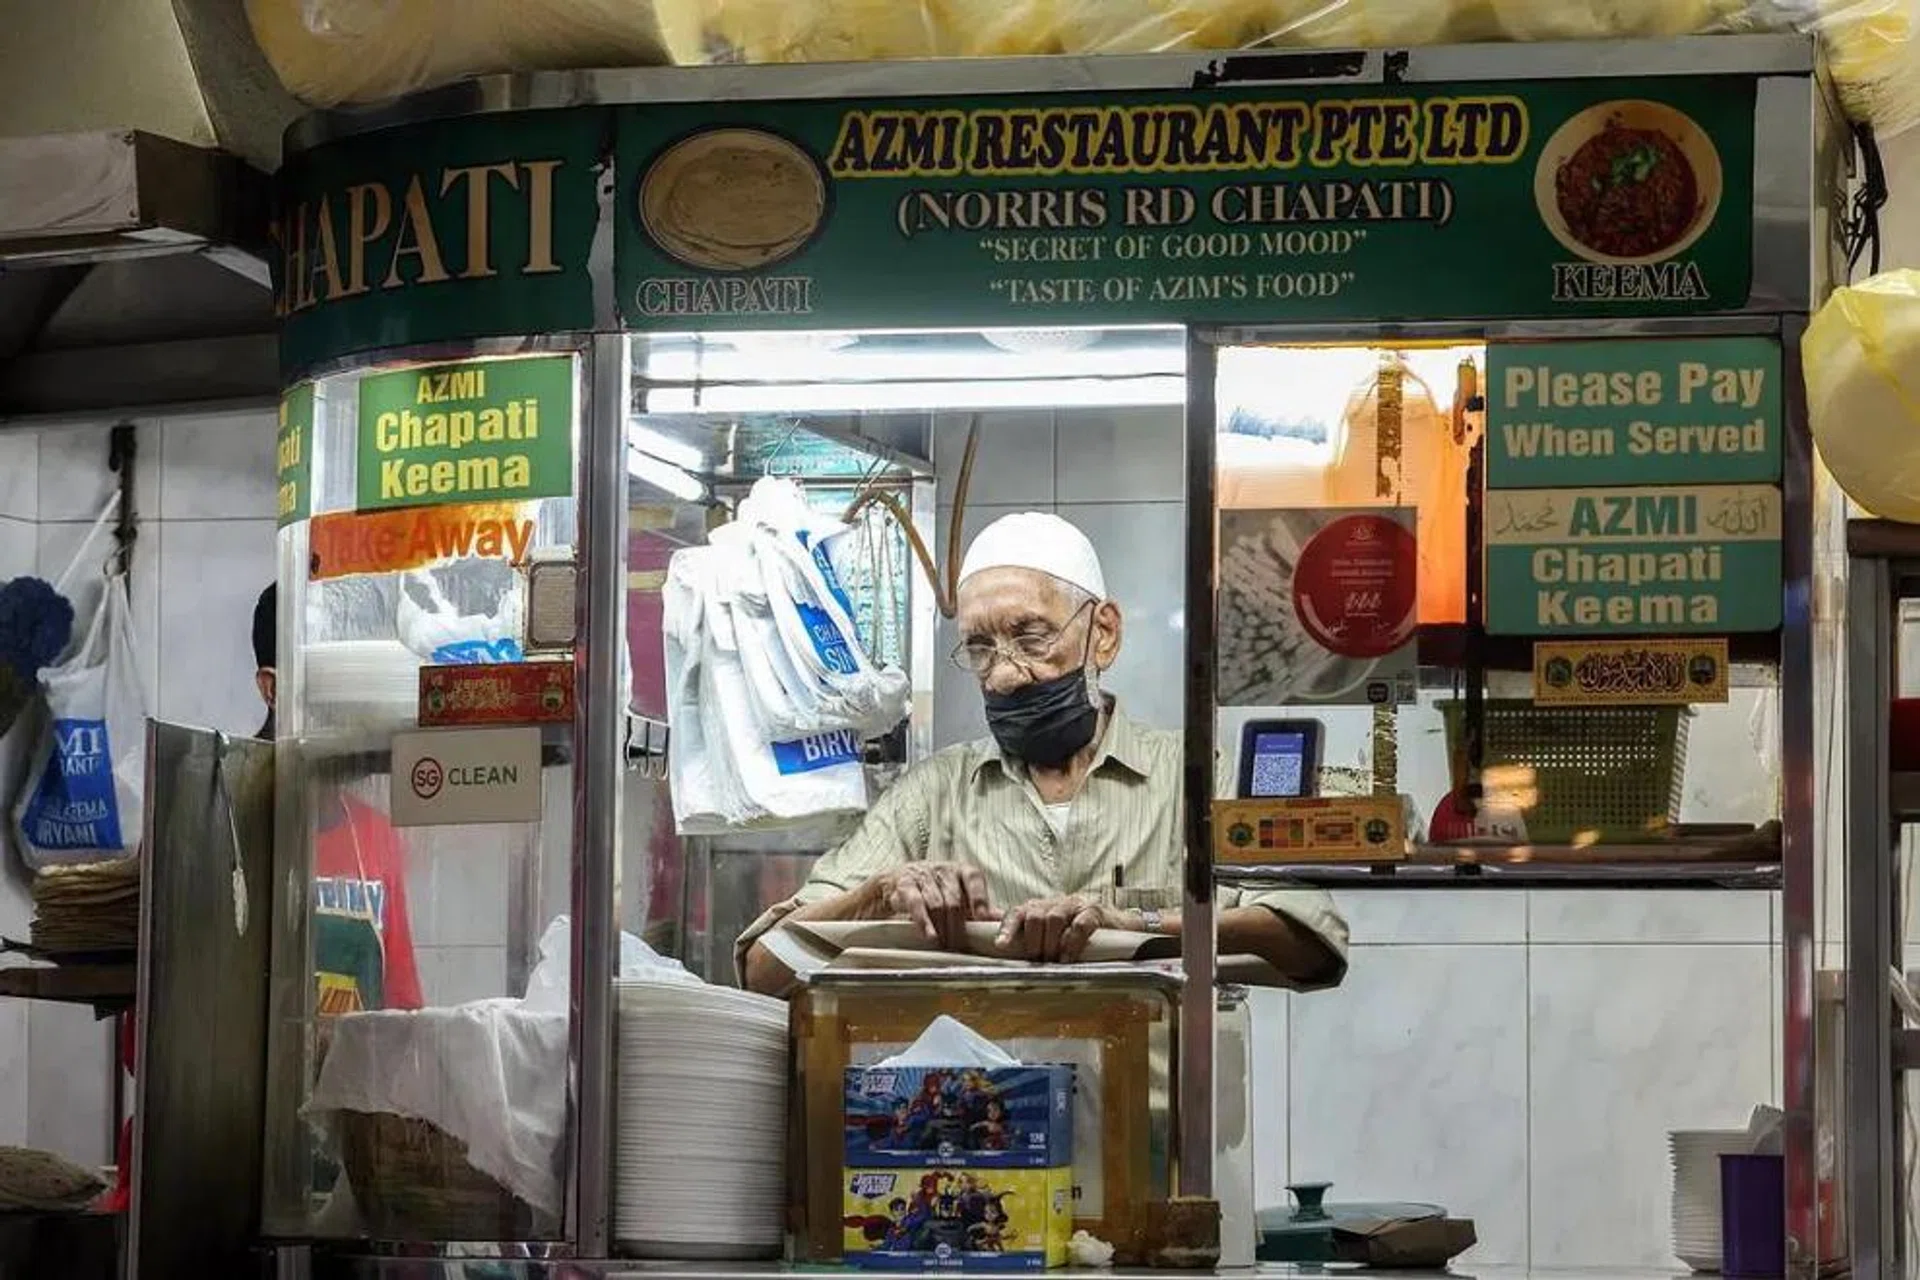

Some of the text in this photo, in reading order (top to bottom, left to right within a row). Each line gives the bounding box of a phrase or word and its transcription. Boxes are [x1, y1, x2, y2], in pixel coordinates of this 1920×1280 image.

[829, 99, 1526, 175] AZMI RESTAURANT PTE LTD
[899, 179, 1455, 236] (NORRIS RD CHAPATI)
[1114, 235, 1153, 260] OF
[1161, 233, 1250, 259] GOOD
[636, 277, 812, 315] CHAPATI
[1104, 277, 1141, 301] OF
[1552, 262, 1709, 300] KEEMA
[416, 370, 486, 405] AZMI
[1504, 361, 1765, 409] Please Pay
[375, 399, 539, 452] Chapati
[1503, 419, 1766, 459] When Served
[380, 454, 531, 500] Keema
[1567, 494, 1698, 537] AZMI
[1531, 546, 1723, 586] Chapati
[1536, 590, 1719, 626] Keema
[448, 766, 518, 786] CLEAN
